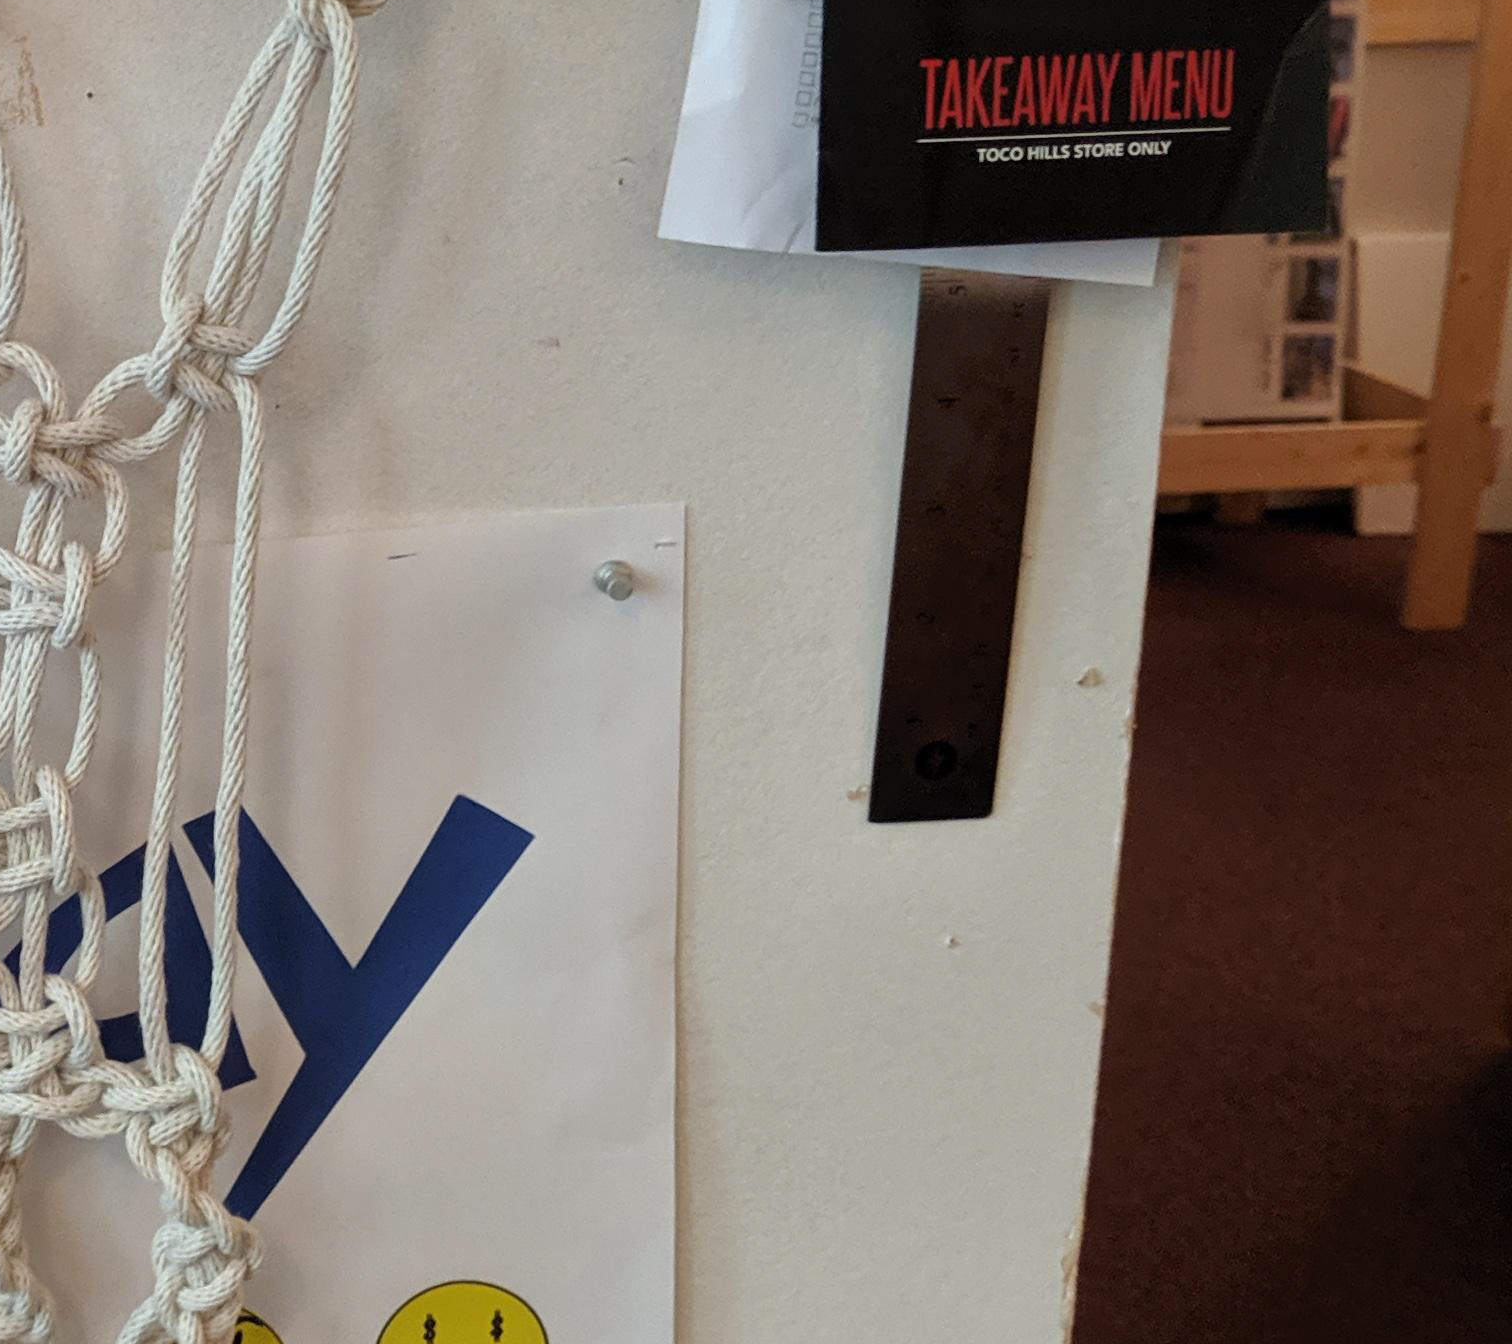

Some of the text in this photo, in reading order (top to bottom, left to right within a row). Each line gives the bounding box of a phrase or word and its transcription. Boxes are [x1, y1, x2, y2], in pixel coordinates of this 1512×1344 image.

[920, 48, 1235, 129] TAKEAWAY MENU
[977, 140, 1172, 163] TOCO HILLS STORE ONLY
